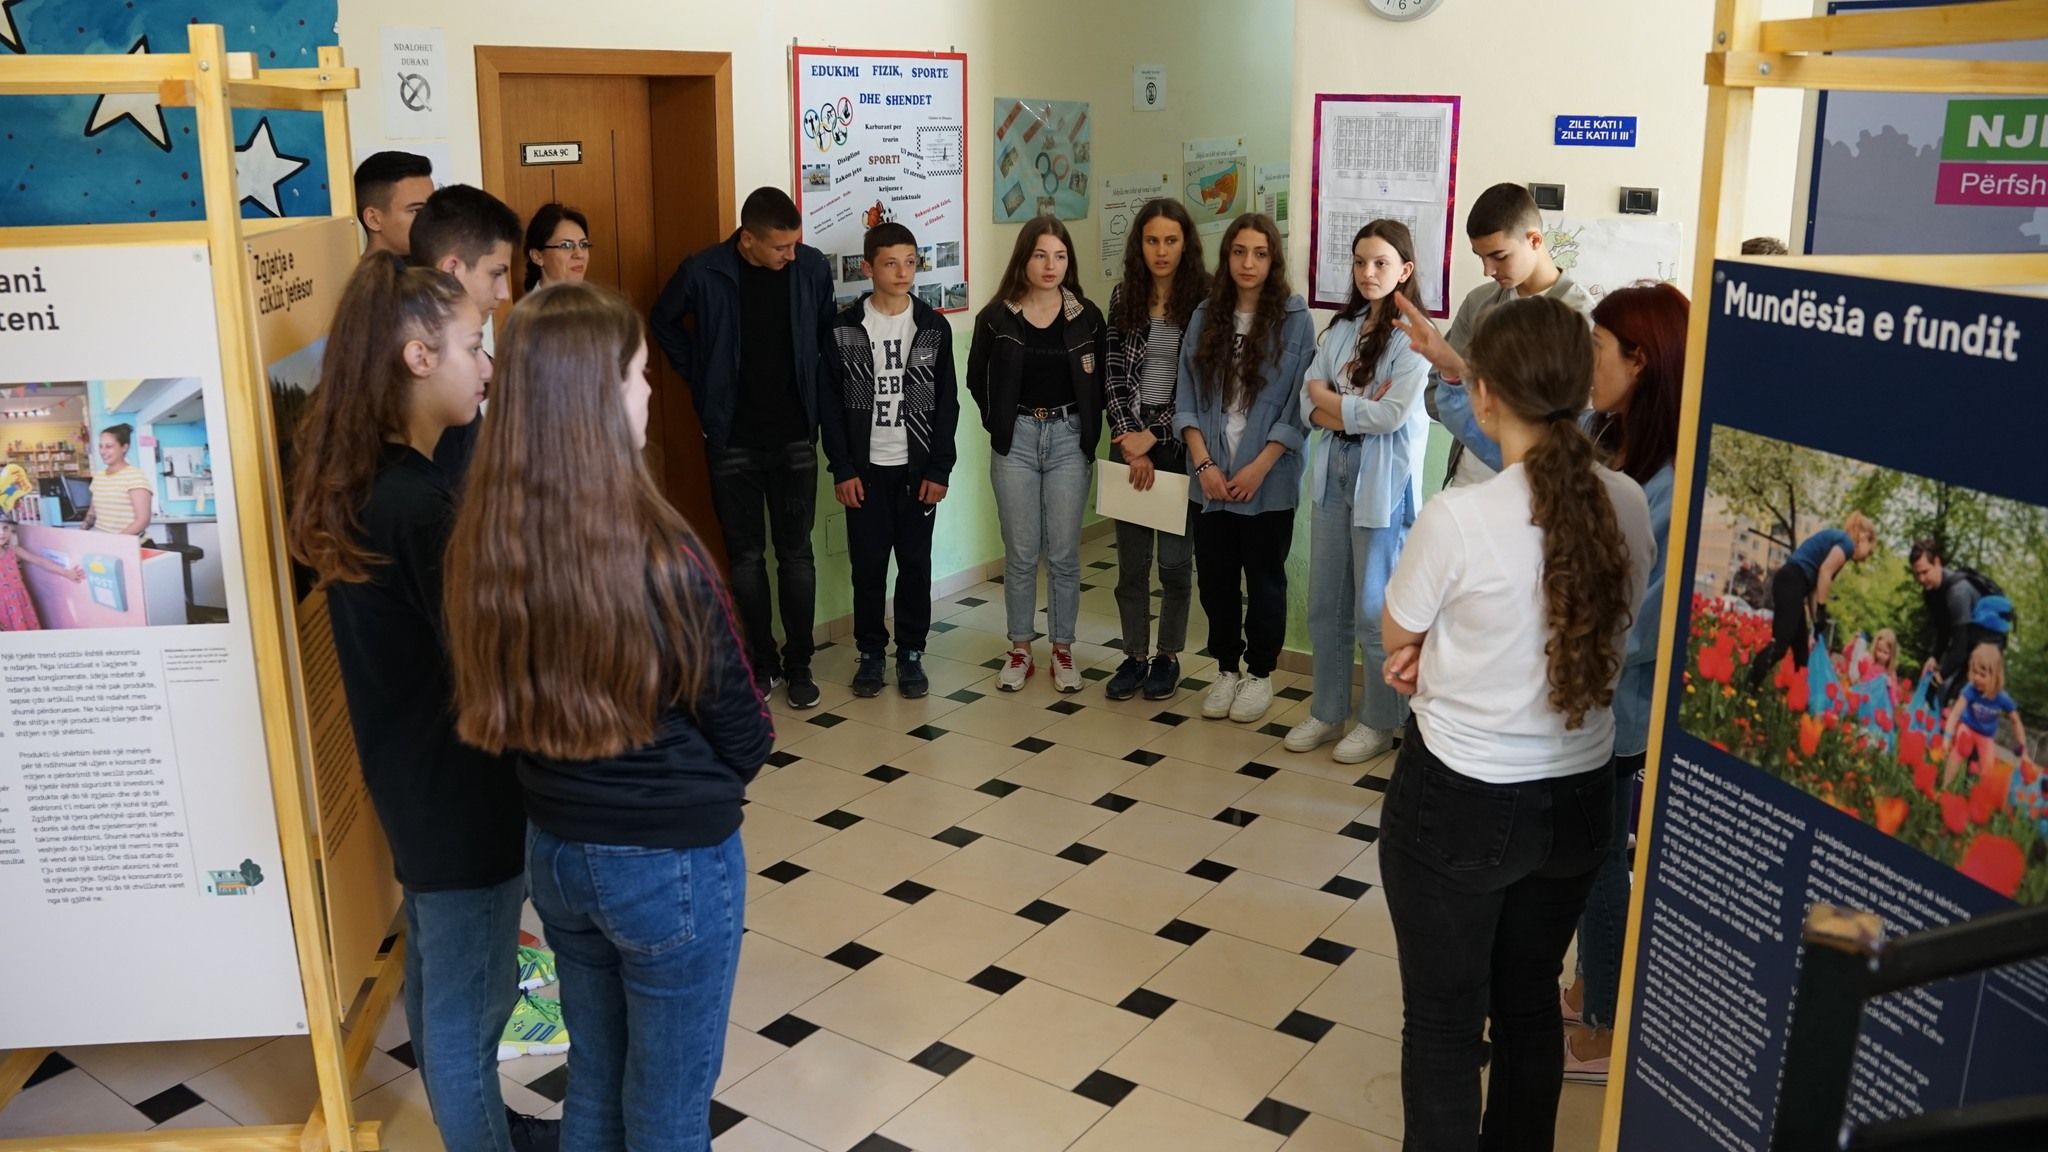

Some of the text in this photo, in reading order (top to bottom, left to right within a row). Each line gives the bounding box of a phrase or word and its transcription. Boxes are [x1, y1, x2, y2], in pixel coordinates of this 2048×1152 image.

[394, 42, 432, 52] NDALOHET
[811, 65, 949, 79] EDUKIMI FIZIK, SPORTE
[859, 93, 932, 106] DHE SHENDET
[1568, 120, 1622, 129] ZILE KATI I
[1561, 131, 1629, 140] ZILE KATI II III
[534, 148, 569, 158] KLASA 9C
[868, 155, 900, 165] SPORTI
[1960, 172, 2046, 196] Përfsh
[254, 251, 294, 285] Zgjatja e
[259, 278, 313, 315] ciklit jetësor
[1724, 280, 2020, 361] Mundësia e fundit
